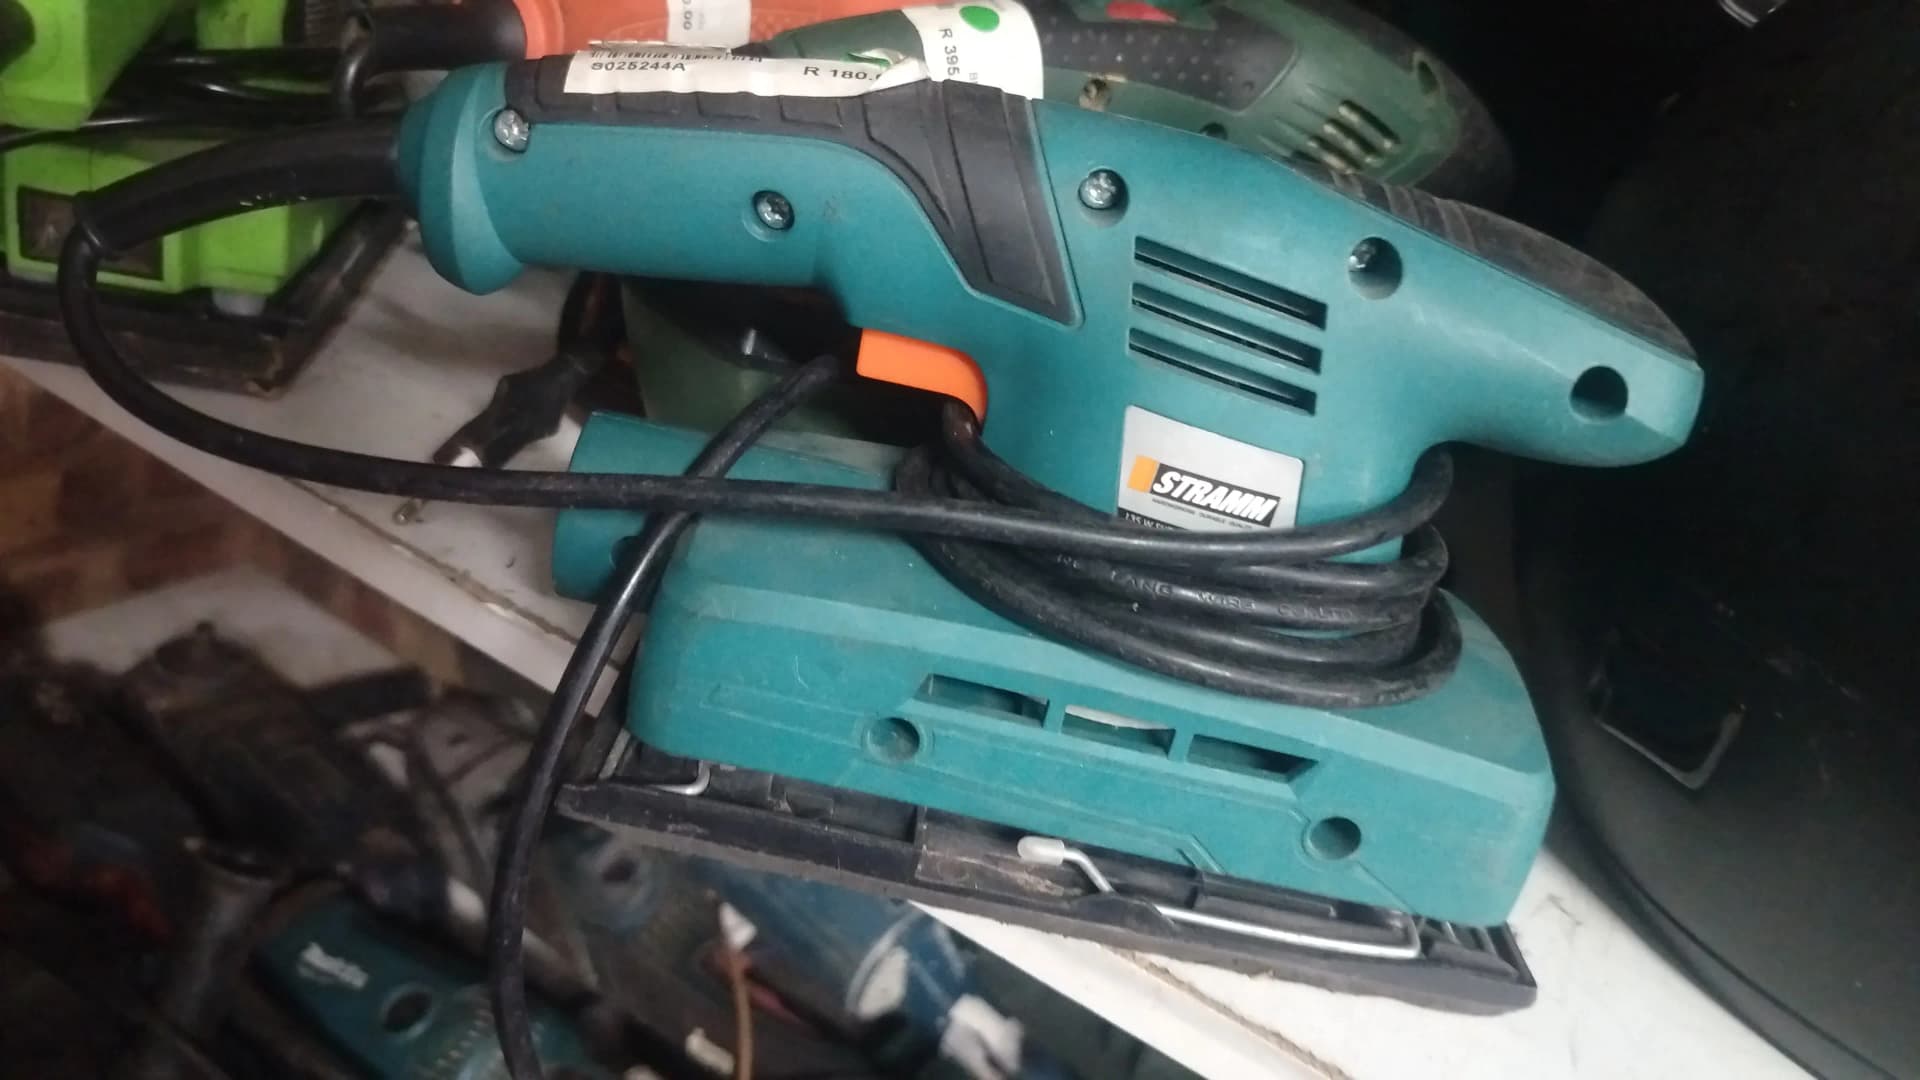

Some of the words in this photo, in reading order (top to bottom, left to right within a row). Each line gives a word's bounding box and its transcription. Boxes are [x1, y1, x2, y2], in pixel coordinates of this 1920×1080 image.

[939, 28, 953, 39] R
[803, 66, 820, 77] R
[1152, 471, 1278, 522] STRAMM
